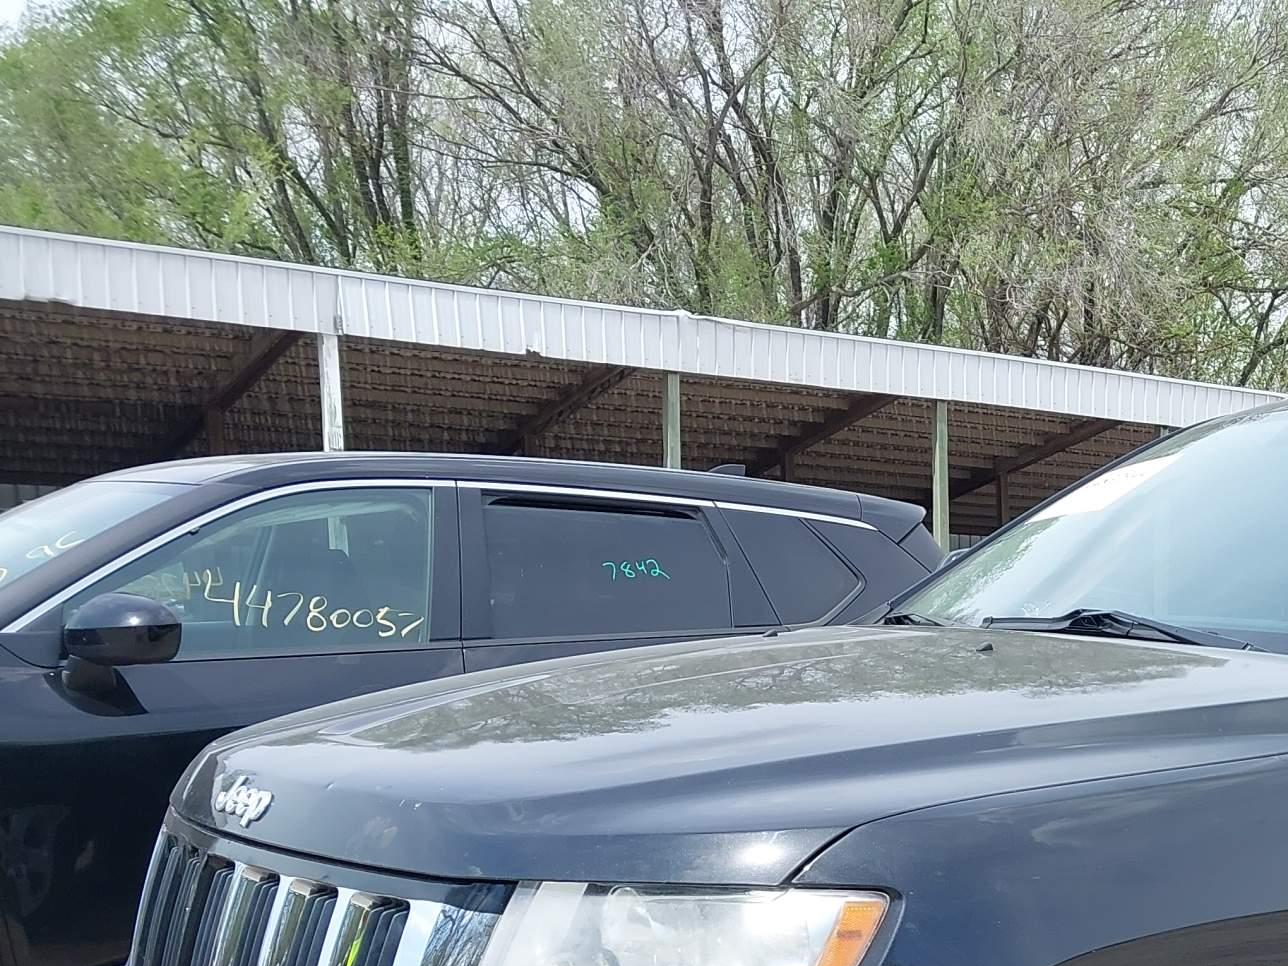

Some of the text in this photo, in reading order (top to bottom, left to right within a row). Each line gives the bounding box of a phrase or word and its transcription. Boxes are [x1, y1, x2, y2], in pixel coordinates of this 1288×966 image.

[602, 559, 671, 581] 7842
[203, 568, 425, 638] 44780057
[215, 775, 273, 829] Jeep
